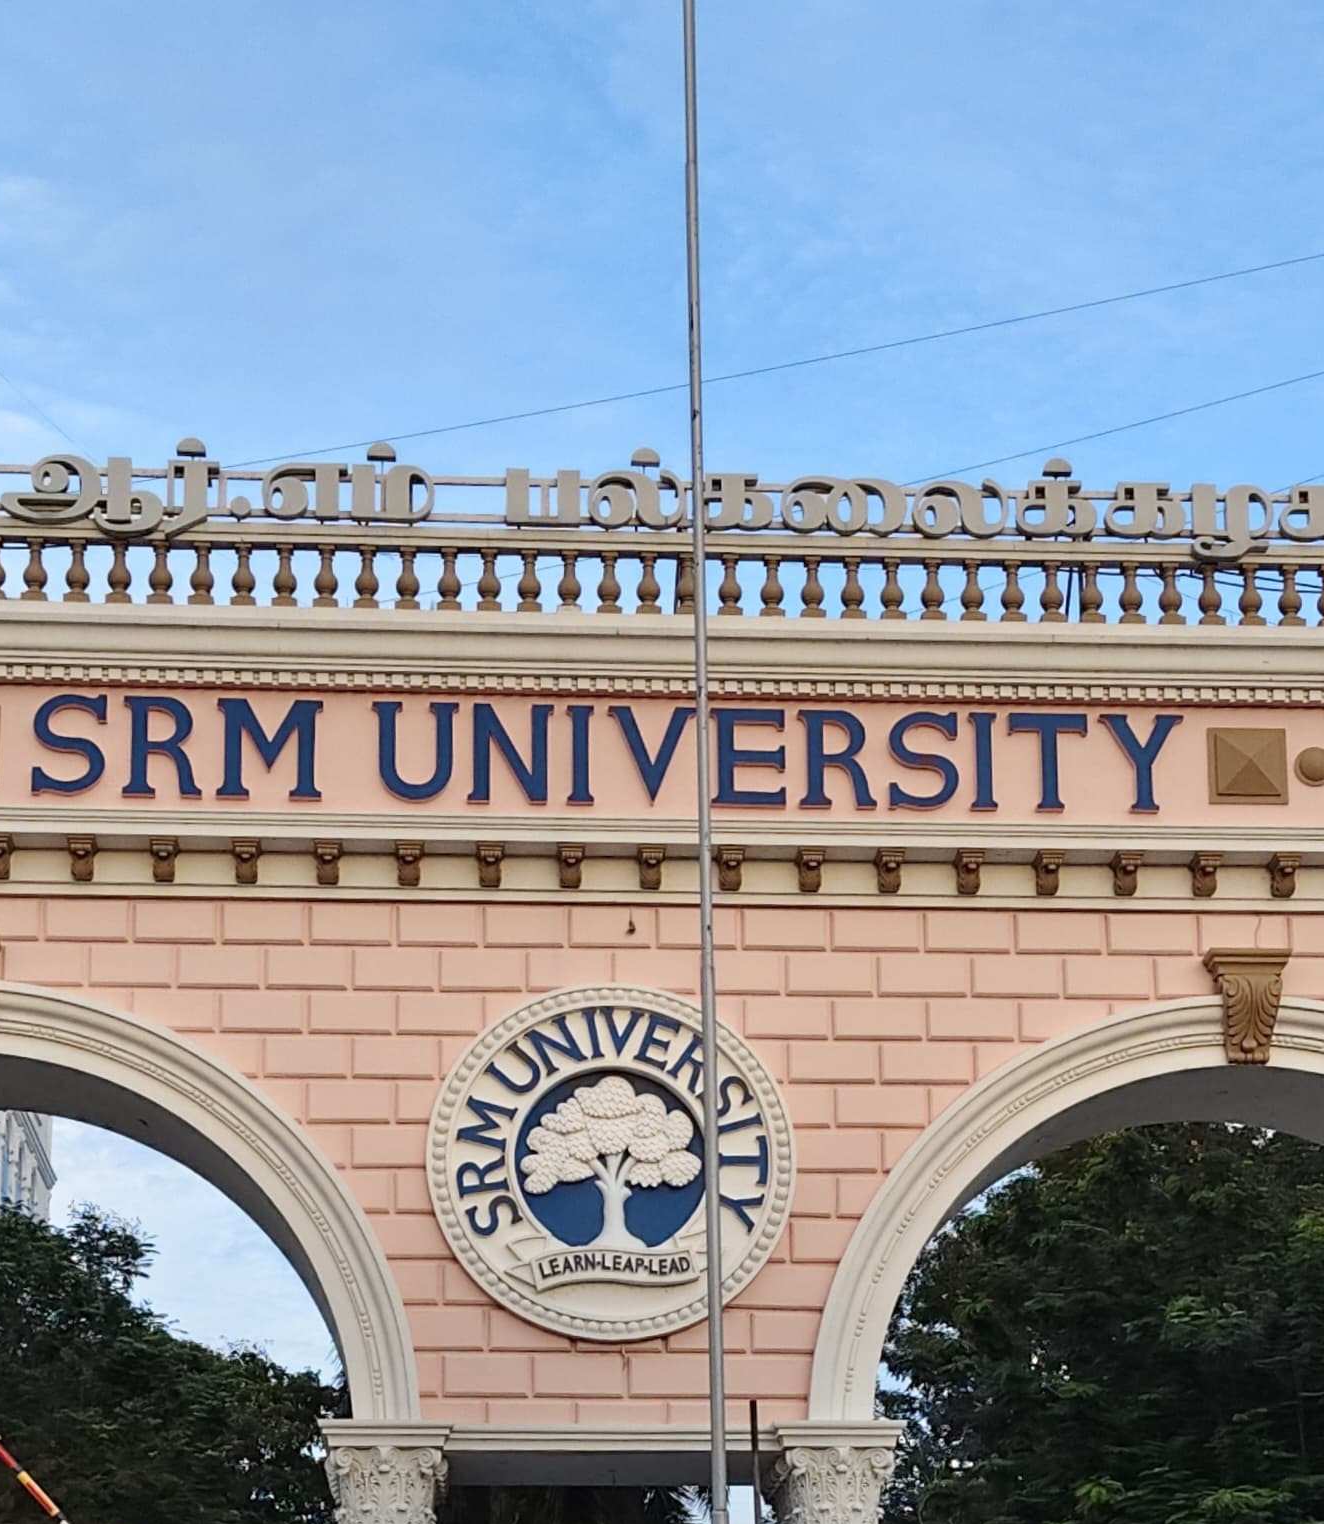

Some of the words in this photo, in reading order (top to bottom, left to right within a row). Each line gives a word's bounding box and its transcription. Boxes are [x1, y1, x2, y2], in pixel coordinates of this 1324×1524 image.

[31, 694, 323, 802] SRM
[372, 701, 1183, 814] UNIVERSITY
[456, 1095, 523, 1237] SRM
[486, 1006, 771, 1234] UNIVERSITY
